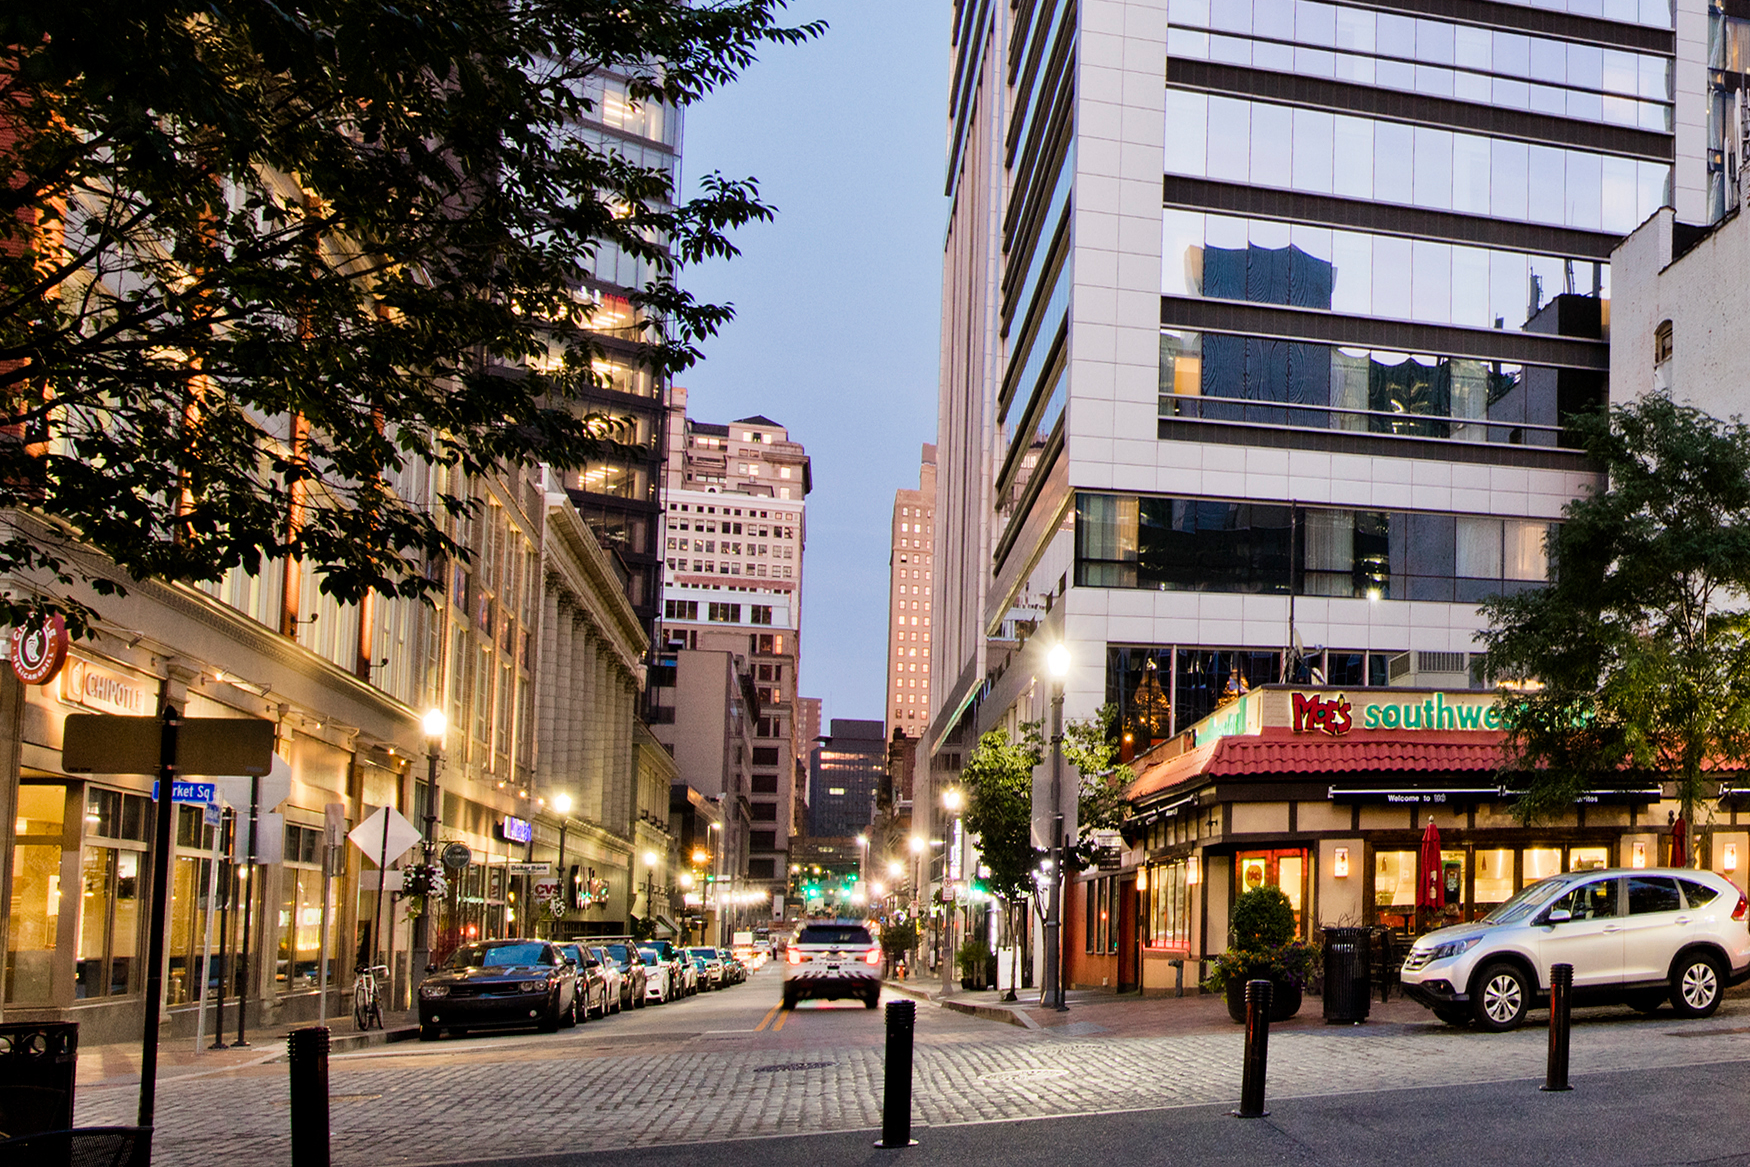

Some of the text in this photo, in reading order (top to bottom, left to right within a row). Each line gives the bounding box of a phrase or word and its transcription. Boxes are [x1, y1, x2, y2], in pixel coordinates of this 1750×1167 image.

[86, 672, 143, 709] CHIPOTLE
[197, 785, 210, 801] Sq
[1387, 794, 1420, 803] Welcome
[1423, 795, 1431, 803] to
